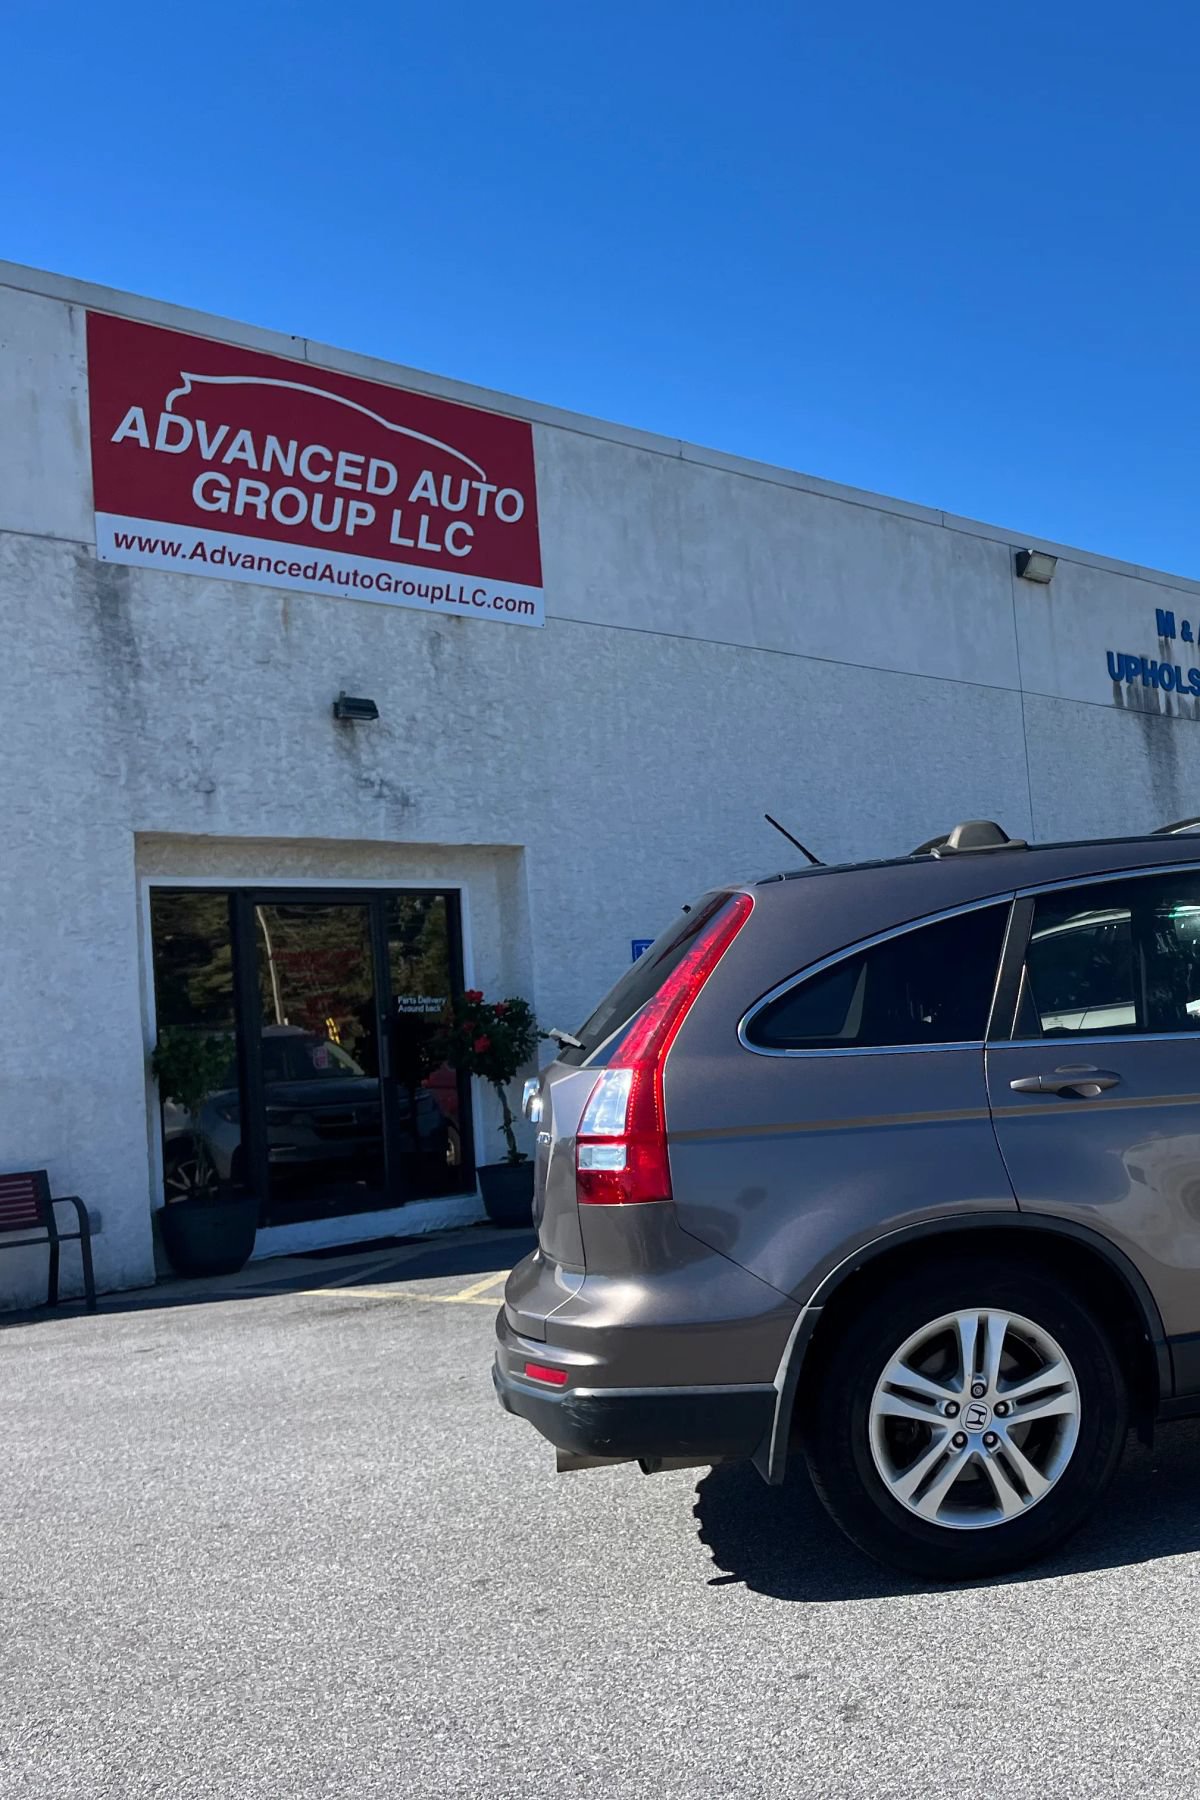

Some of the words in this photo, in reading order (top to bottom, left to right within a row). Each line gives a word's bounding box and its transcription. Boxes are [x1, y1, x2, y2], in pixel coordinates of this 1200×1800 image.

[110, 406, 398, 497] ADVANCED
[408, 469, 525, 524] AUTO
[192, 471, 376, 536] GROUP
[389, 509, 475, 557] LLC
[113, 531, 535, 616] www.AdvancedAutoGroupLLC.com
[1155, 608, 1176, 639] M
[1181, 620, 1194, 643] &
